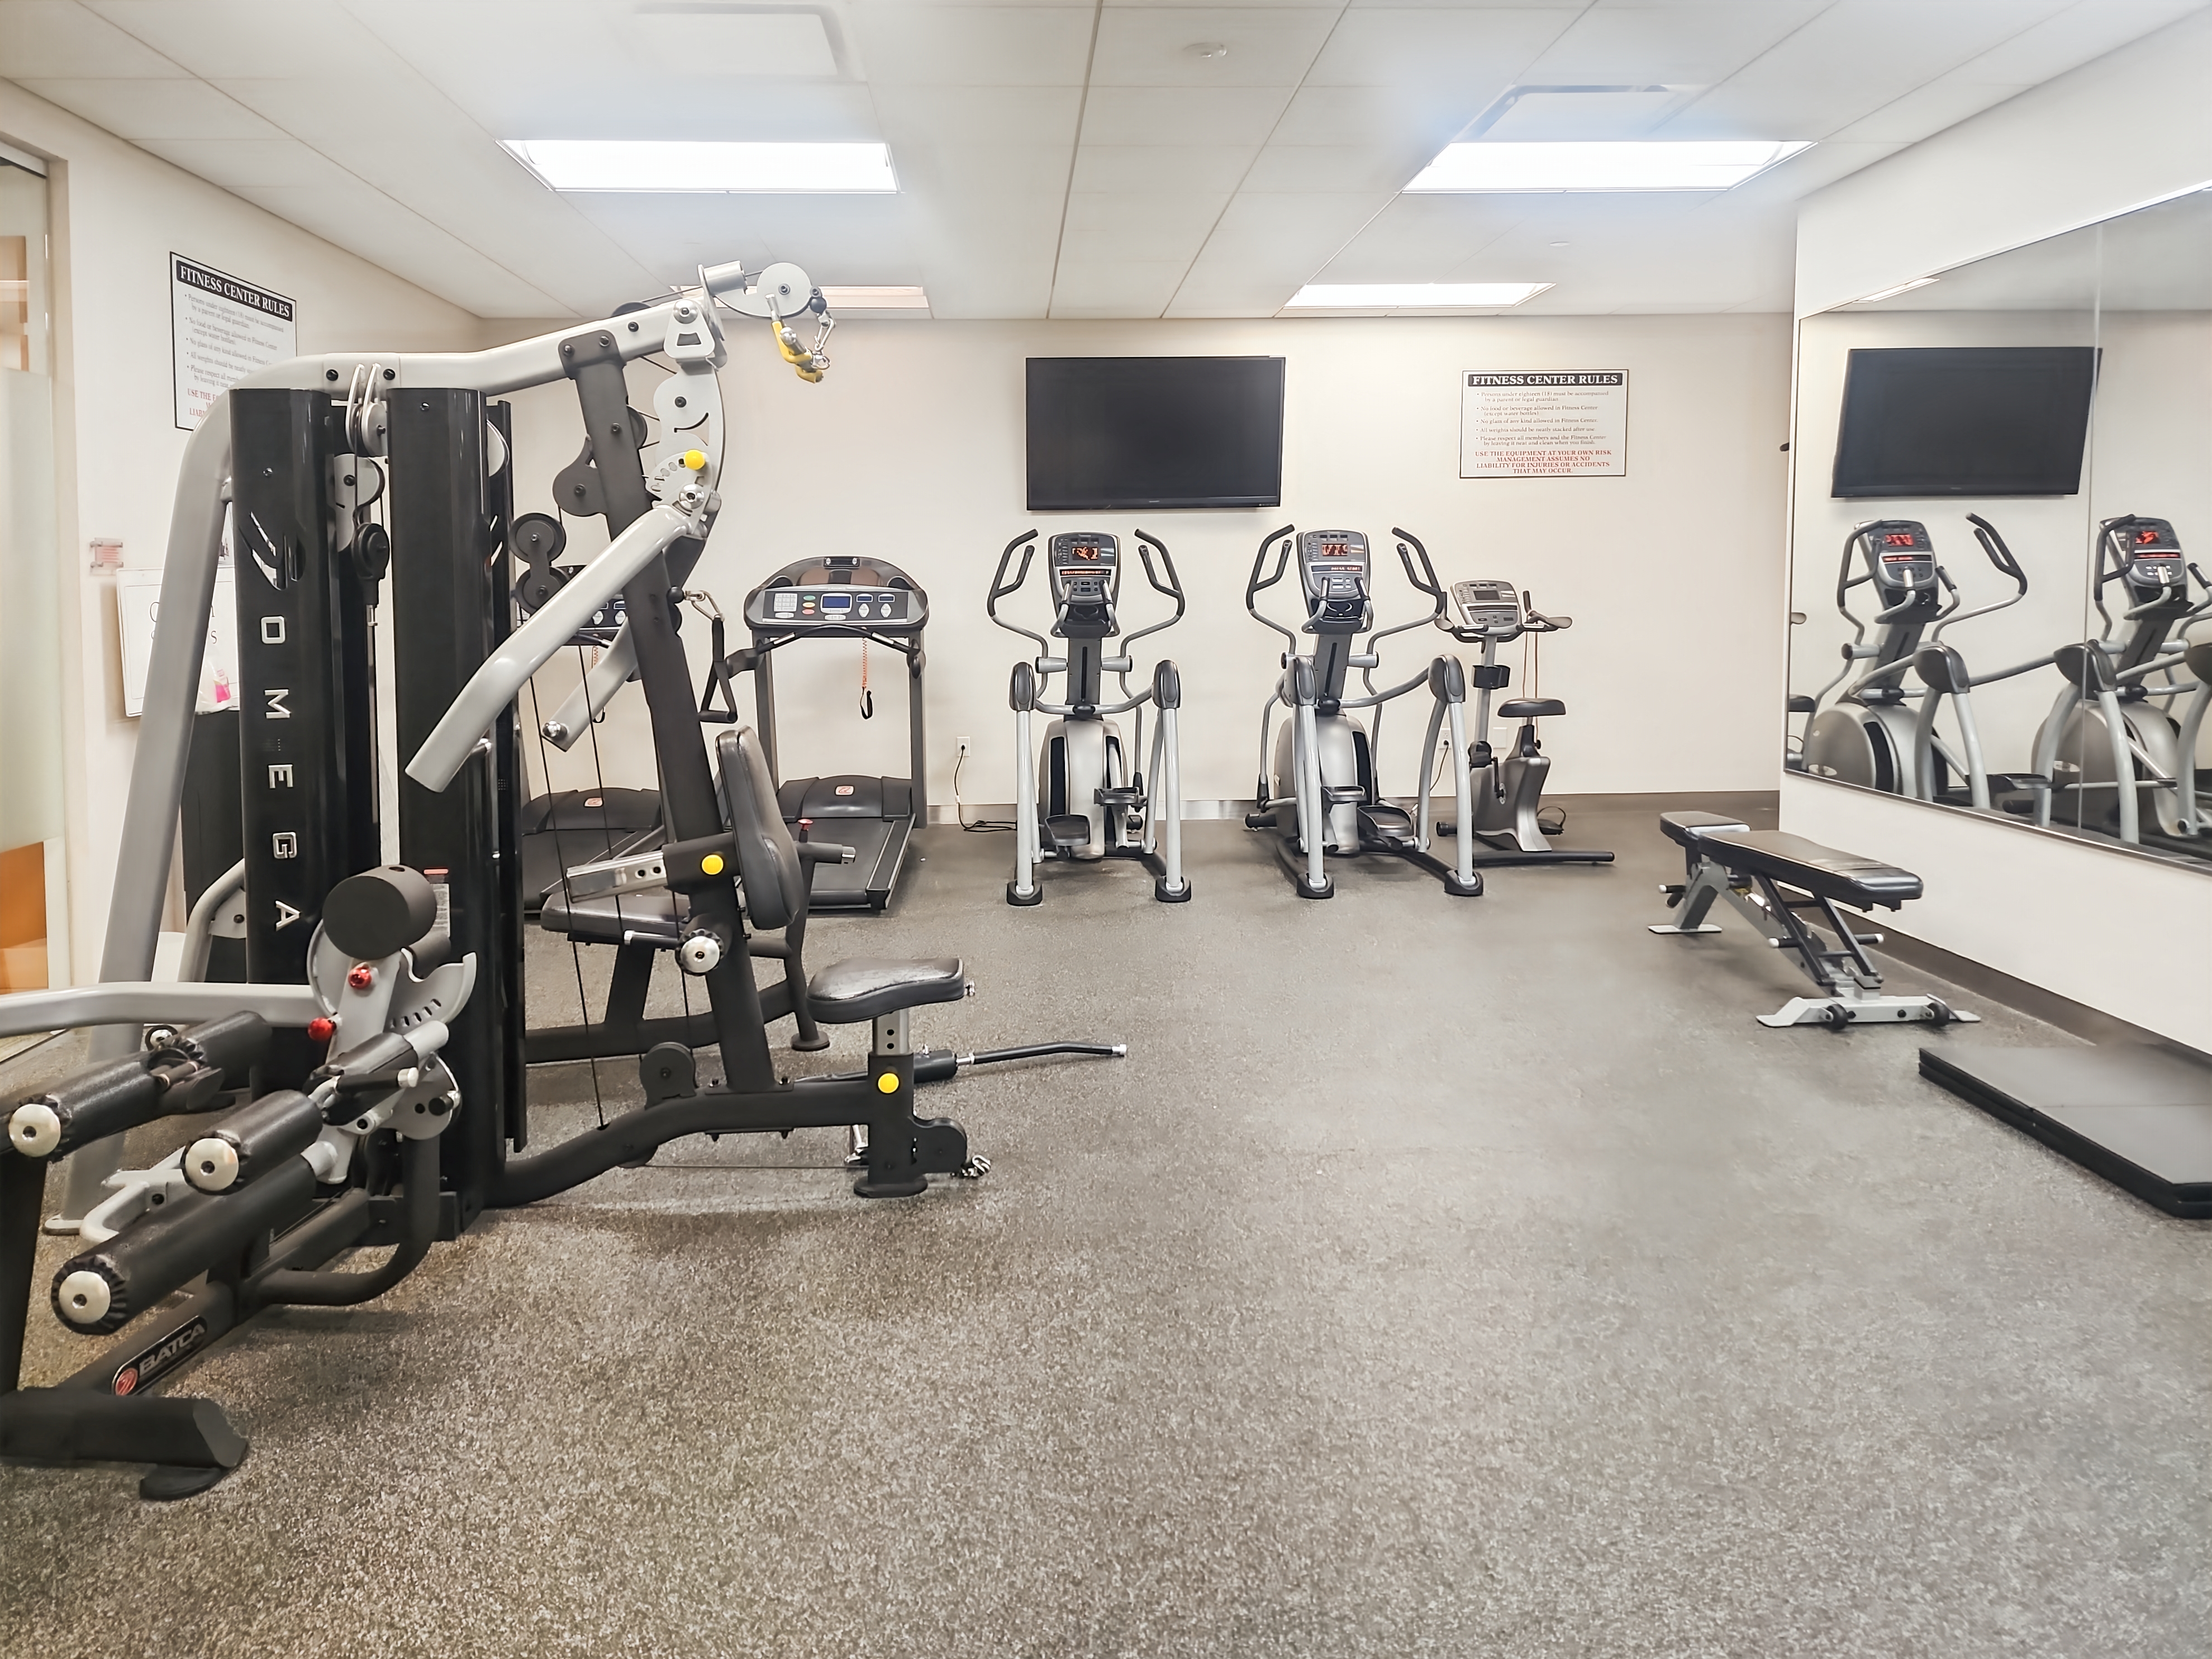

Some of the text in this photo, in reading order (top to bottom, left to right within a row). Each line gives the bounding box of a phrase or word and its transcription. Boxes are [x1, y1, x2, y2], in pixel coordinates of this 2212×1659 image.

[180, 265, 289, 317] FITNESS CENTER RULES
[187, 388, 198, 398] USE
[199, 391, 211, 401] THE
[1472, 375, 1618, 385] FITNESS CENTER RULES
[260, 615, 301, 931] OMEGA
[139, 1323, 206, 1377] BATCA
